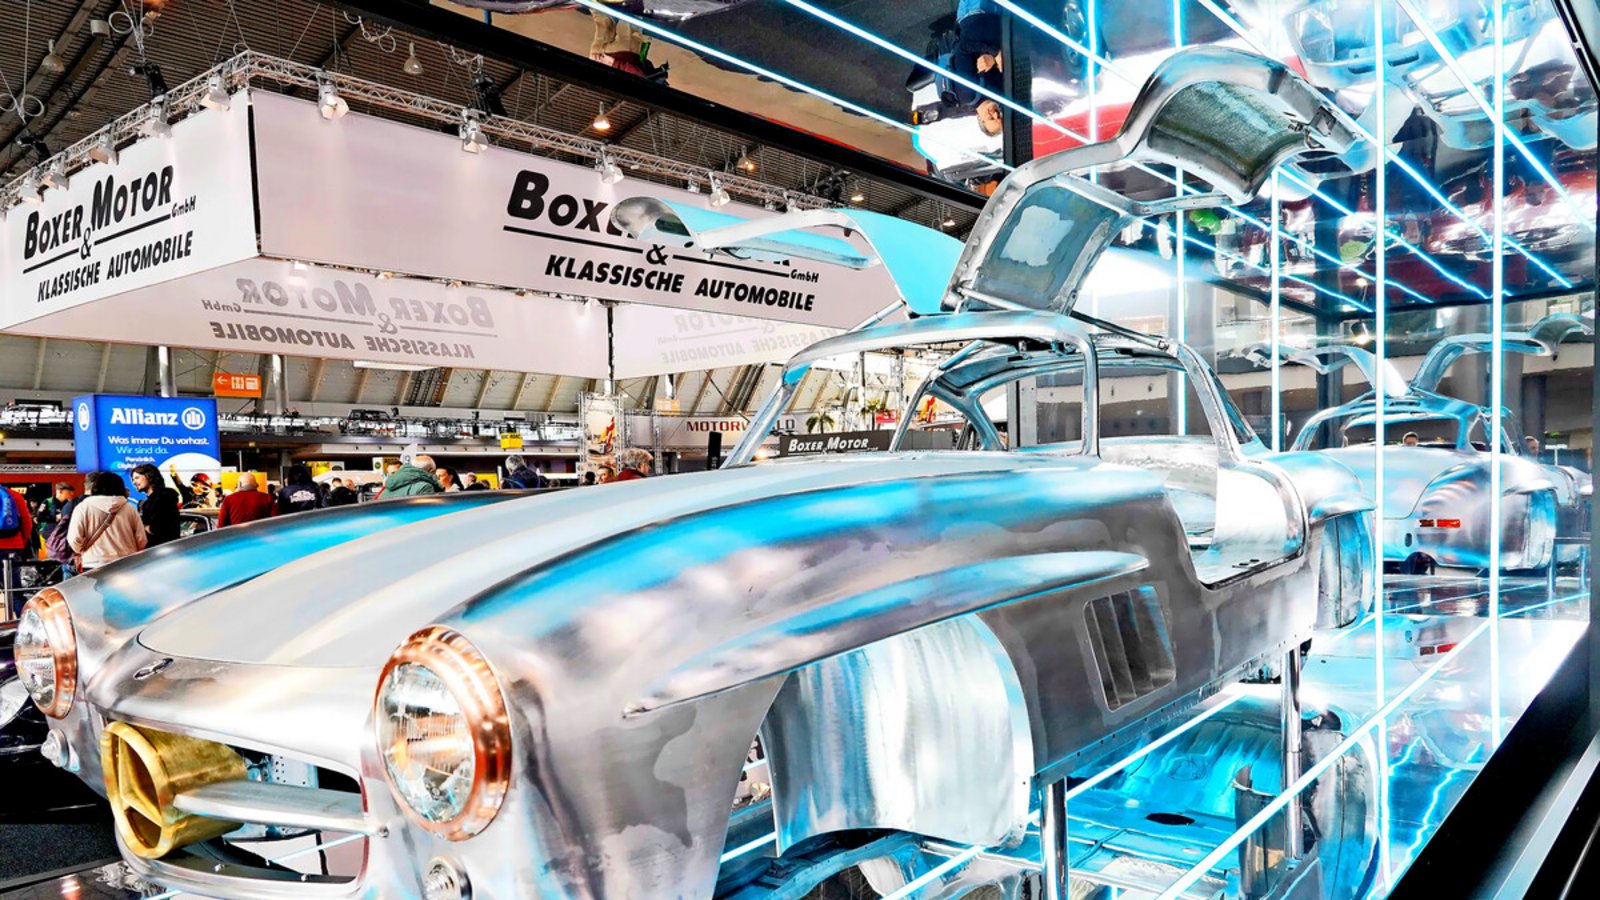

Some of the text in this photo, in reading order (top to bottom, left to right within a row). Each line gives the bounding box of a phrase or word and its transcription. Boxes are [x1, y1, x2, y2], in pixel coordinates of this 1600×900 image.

[24, 165, 197, 260] BOXER & MOTOR GmbH
[506, 169, 820, 283] BOX & GmbH
[37, 230, 194, 303] KLASSISCHE AUTOMOBILE
[544, 254, 816, 312] KLASSISCHE AUTOMOBILE
[110, 407, 179, 425] Allianz
[687, 419, 796, 432] MOTORLD
[108, 435, 209, 445] Was immer Du vorhast.
[788, 437, 824, 452] BOXER
[827, 436, 869, 450] MOTOR
[116, 445, 169, 454] Wir sind da.
